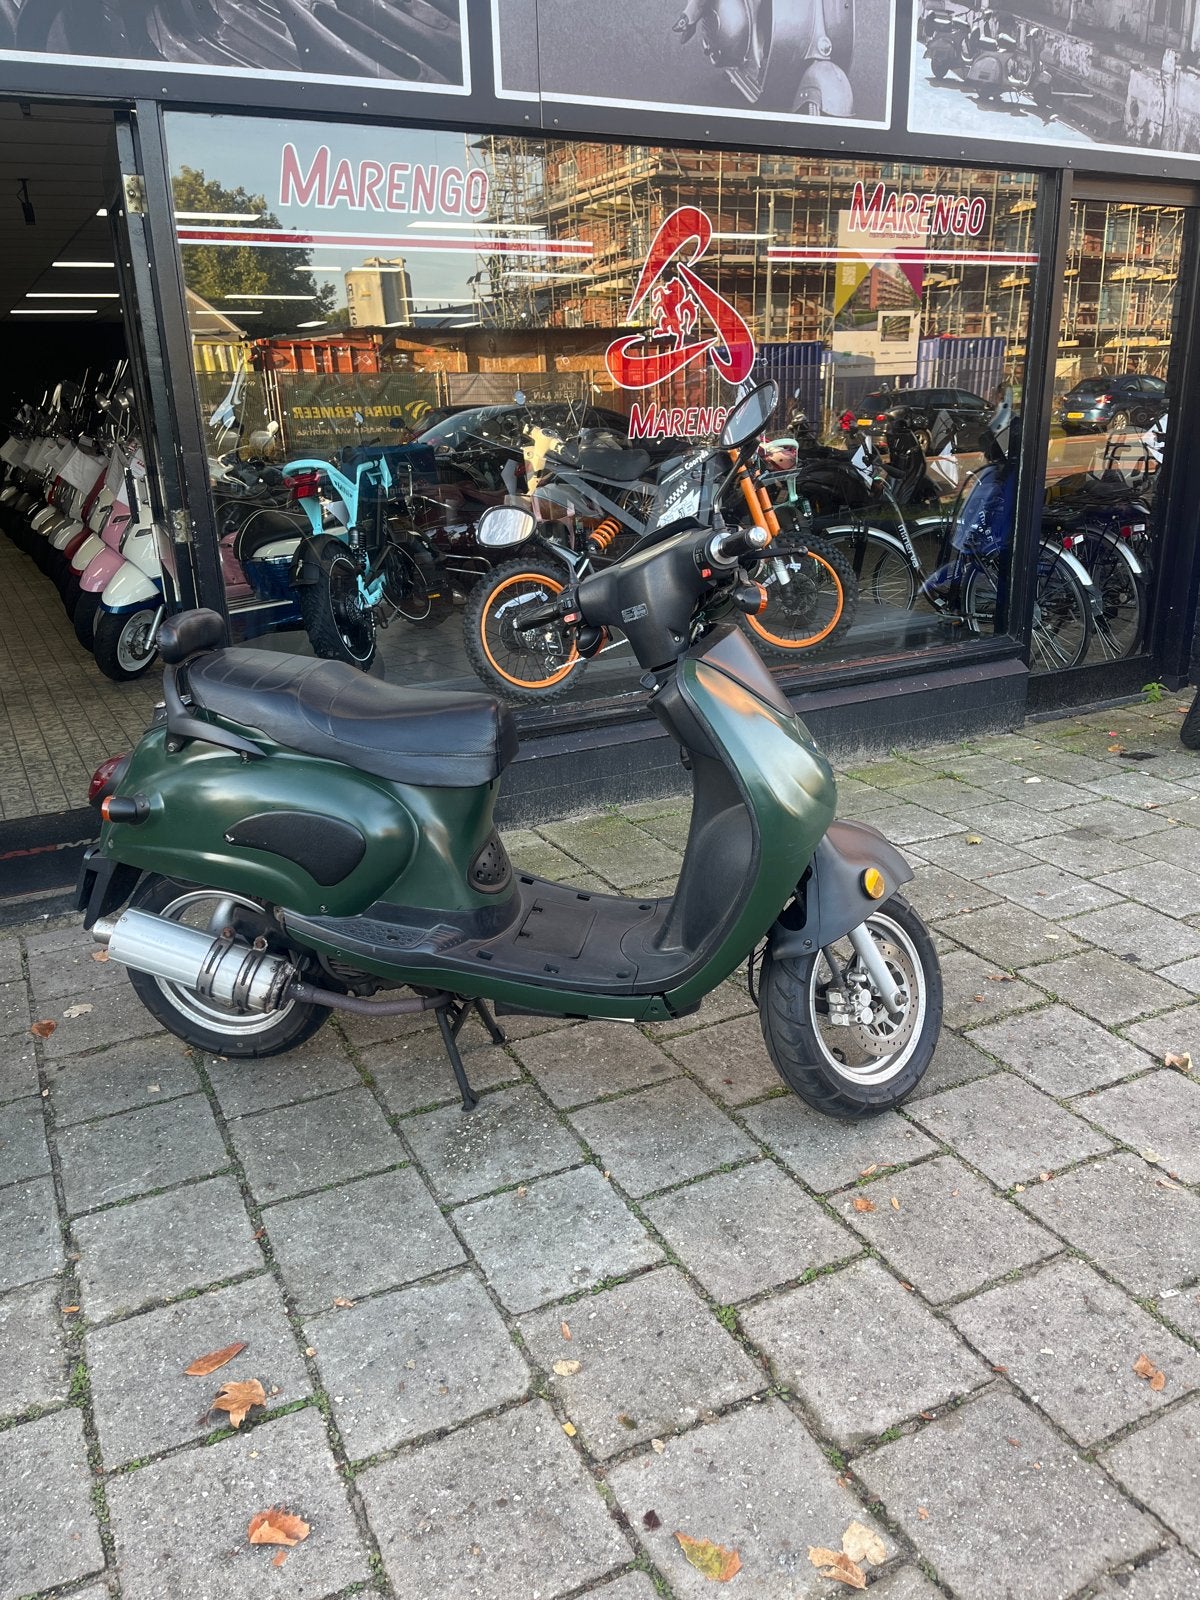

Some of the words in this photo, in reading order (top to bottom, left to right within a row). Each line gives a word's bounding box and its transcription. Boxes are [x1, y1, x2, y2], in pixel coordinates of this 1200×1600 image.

[279, 142, 489, 216] MARENGO
[848, 181, 986, 236] MARENGO
[628, 402, 735, 439] MARENG
[898, 524, 920, 568] minerva
